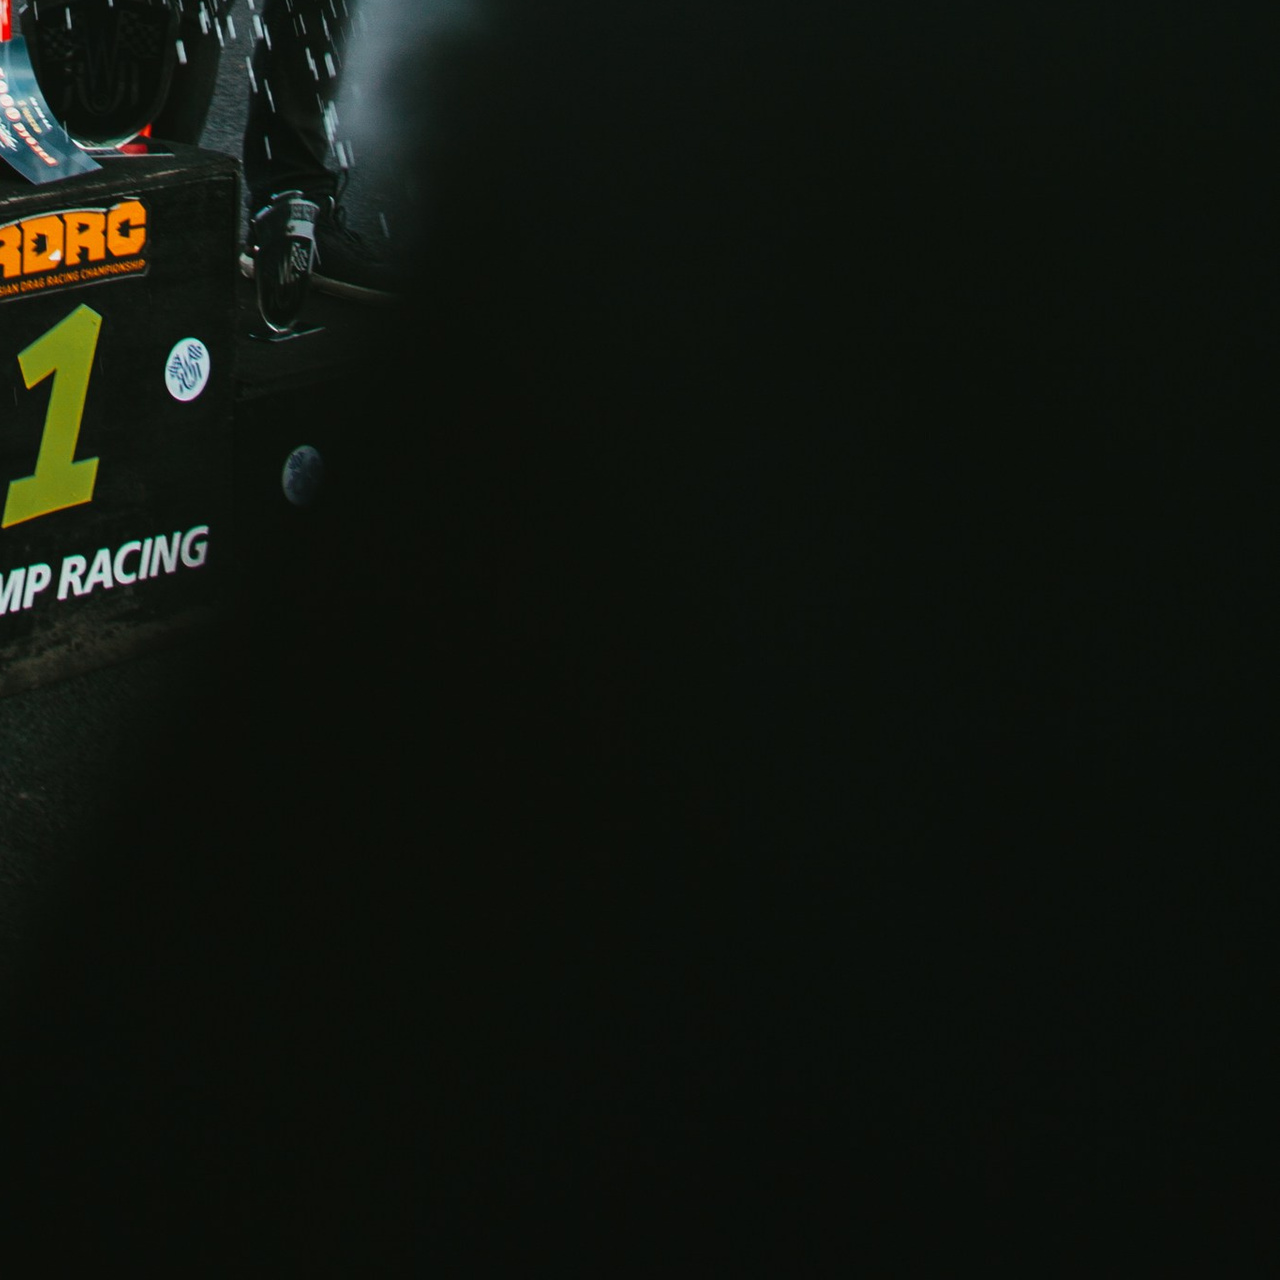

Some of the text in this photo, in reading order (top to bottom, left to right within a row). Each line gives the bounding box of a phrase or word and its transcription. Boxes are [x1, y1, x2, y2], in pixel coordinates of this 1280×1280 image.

[20, 277, 46, 293] DRAG
[46, 270, 81, 287] RACING
[80, 258, 147, 280] CHAMPIONSHIP
[0, 302, 104, 529] 1
[56, 524, 210, 602] RACING
